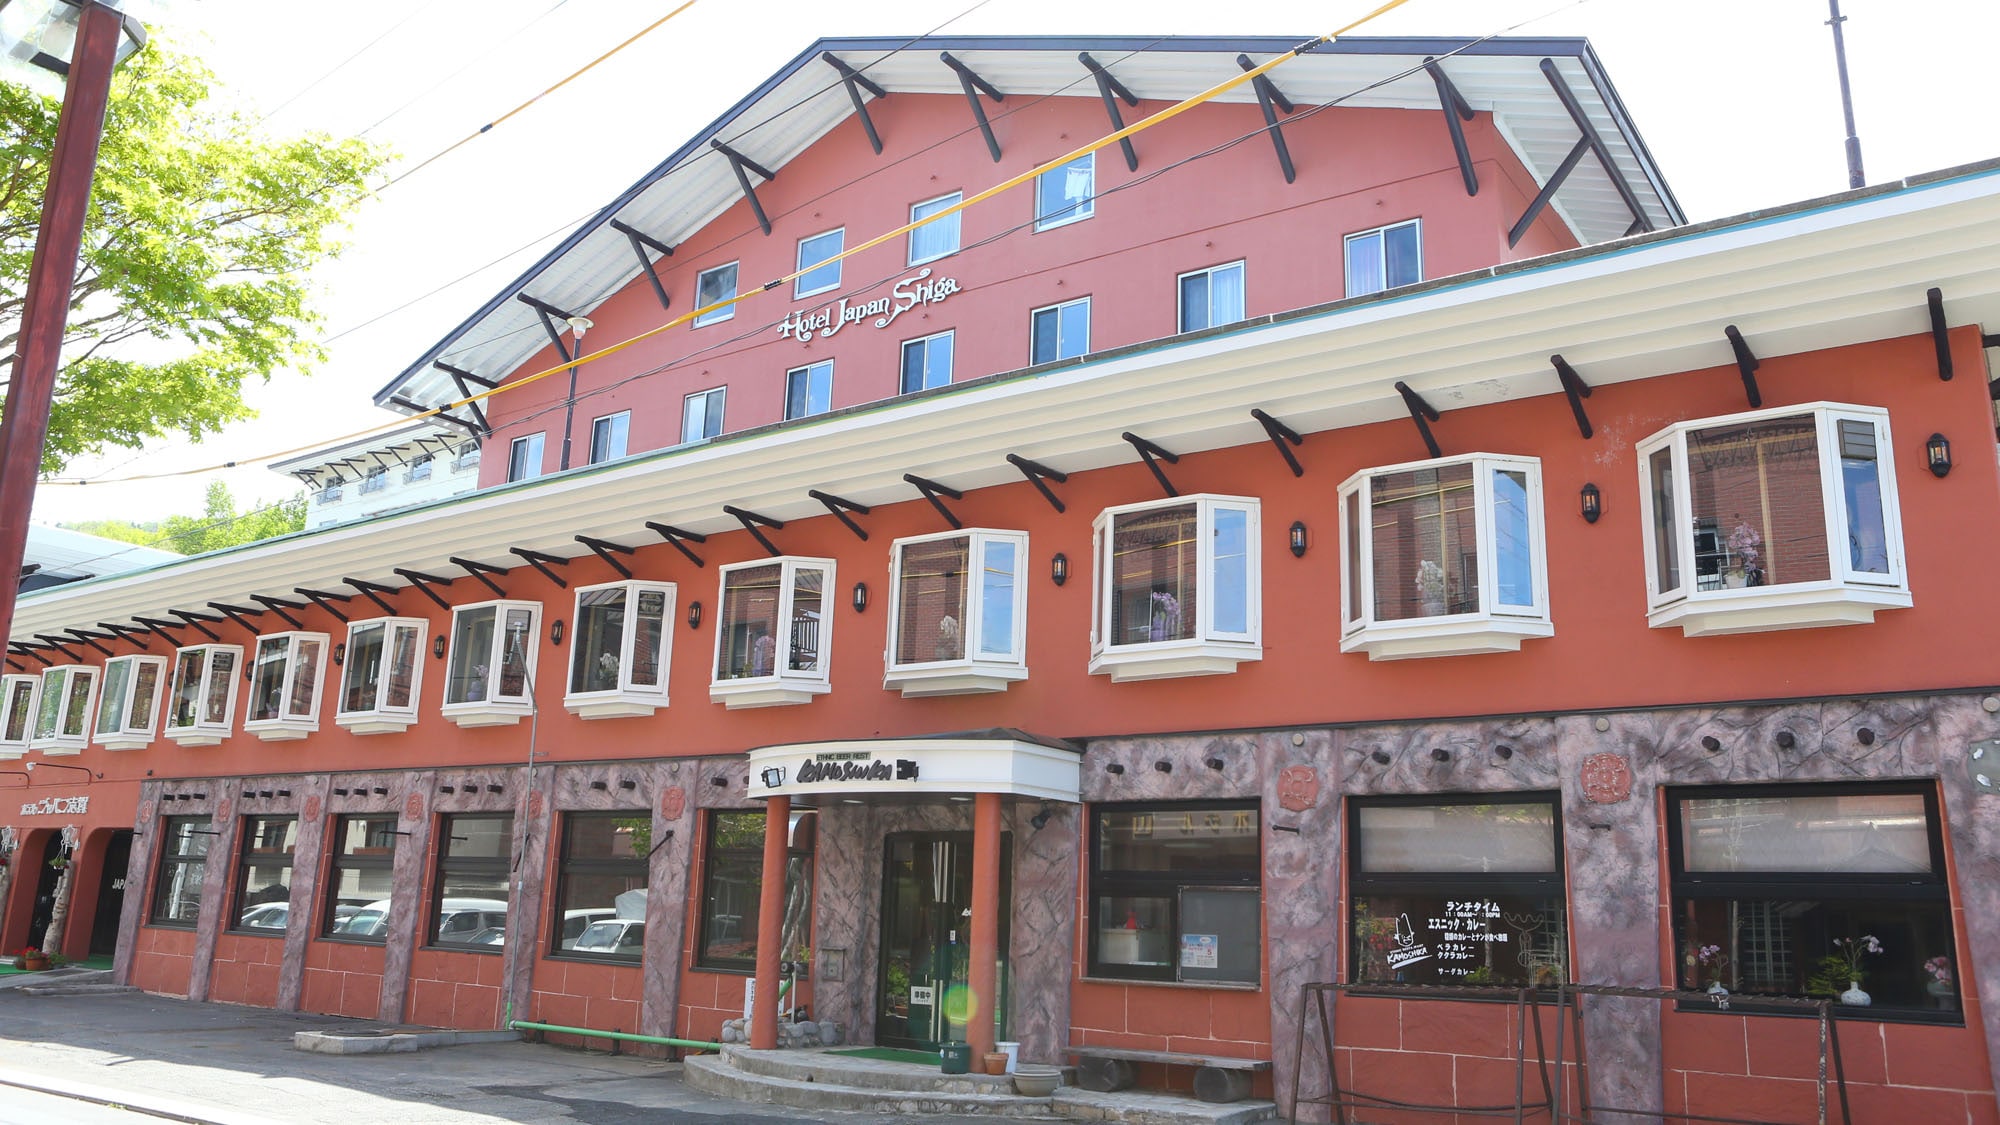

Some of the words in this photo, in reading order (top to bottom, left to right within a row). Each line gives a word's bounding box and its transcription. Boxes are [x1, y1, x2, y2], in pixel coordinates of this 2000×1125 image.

[777, 307, 830, 342] Hotel
[821, 298, 890, 337] Japan
[875, 267, 961, 329] Shiga
[1447, 902, 1500, 912] ランチタイム
[1387, 947, 1428, 964] KAMOSHIKA
